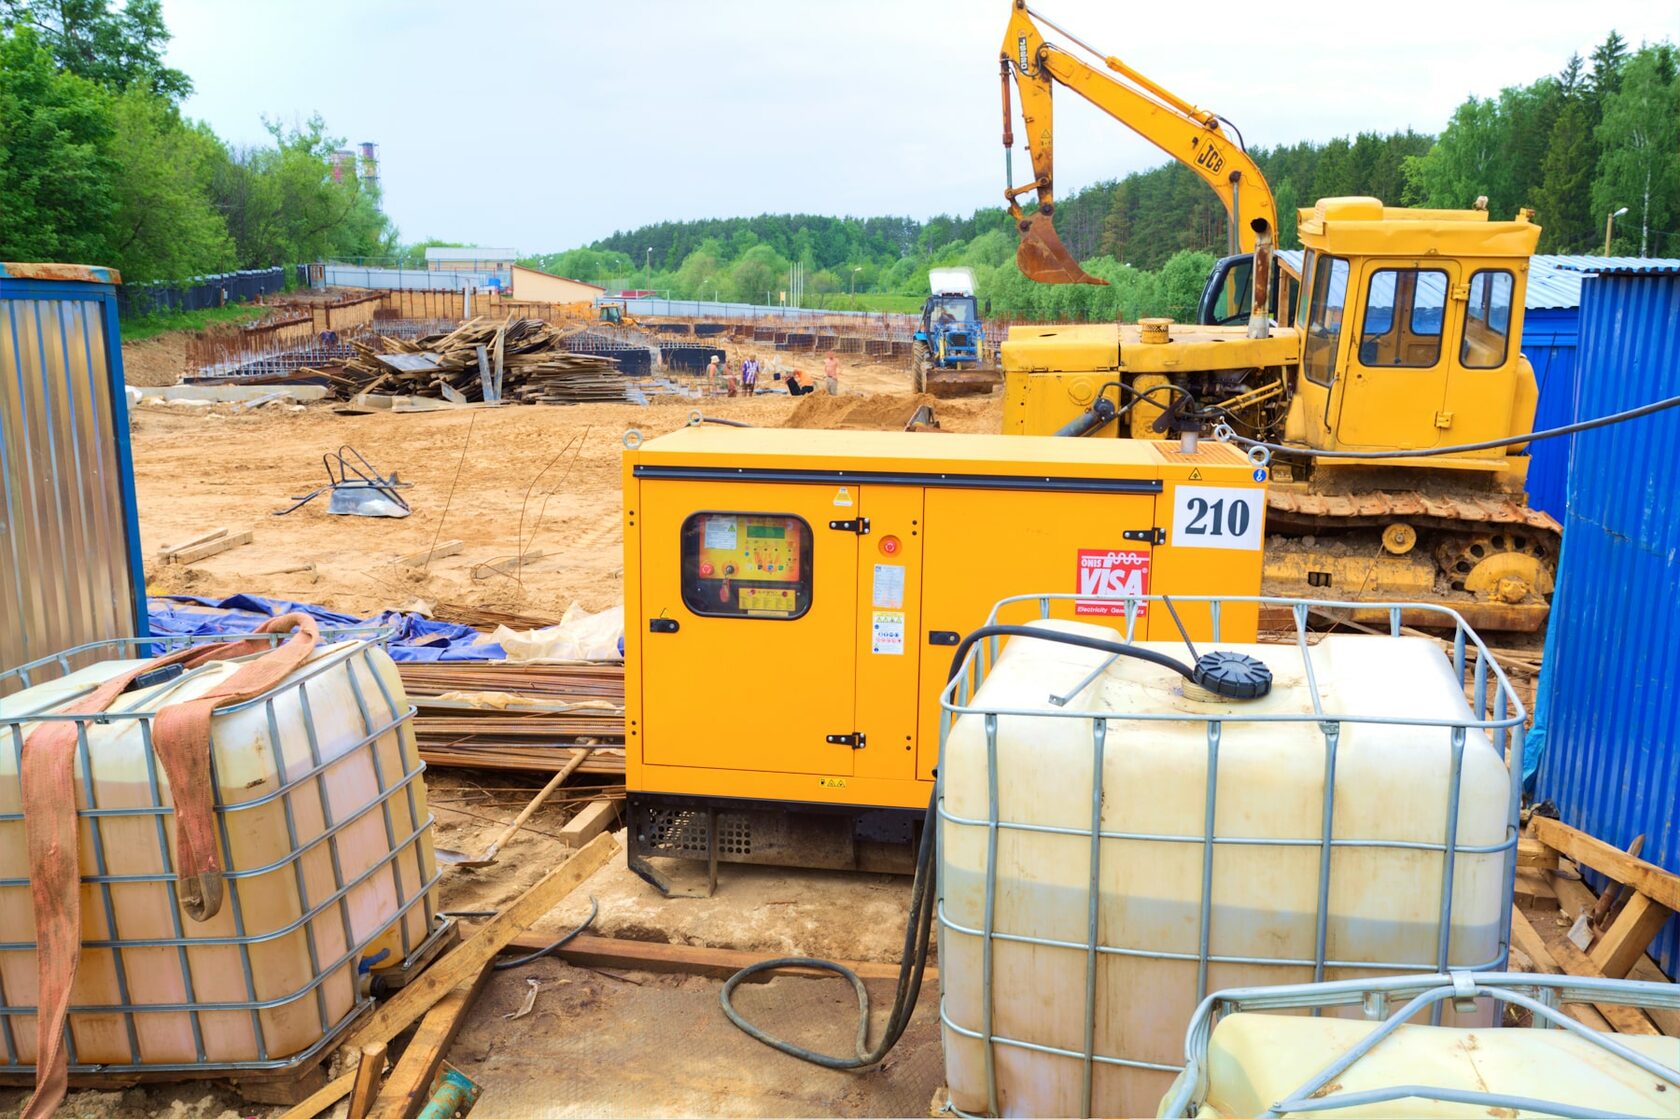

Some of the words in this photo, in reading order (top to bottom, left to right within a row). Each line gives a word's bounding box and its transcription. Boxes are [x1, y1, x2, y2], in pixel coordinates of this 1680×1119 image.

[1197, 144, 1223, 172] JCB
[1185, 497, 1250, 537] 210
[1081, 558, 1102, 568] ONIS
[1081, 568, 1143, 602] VISA
